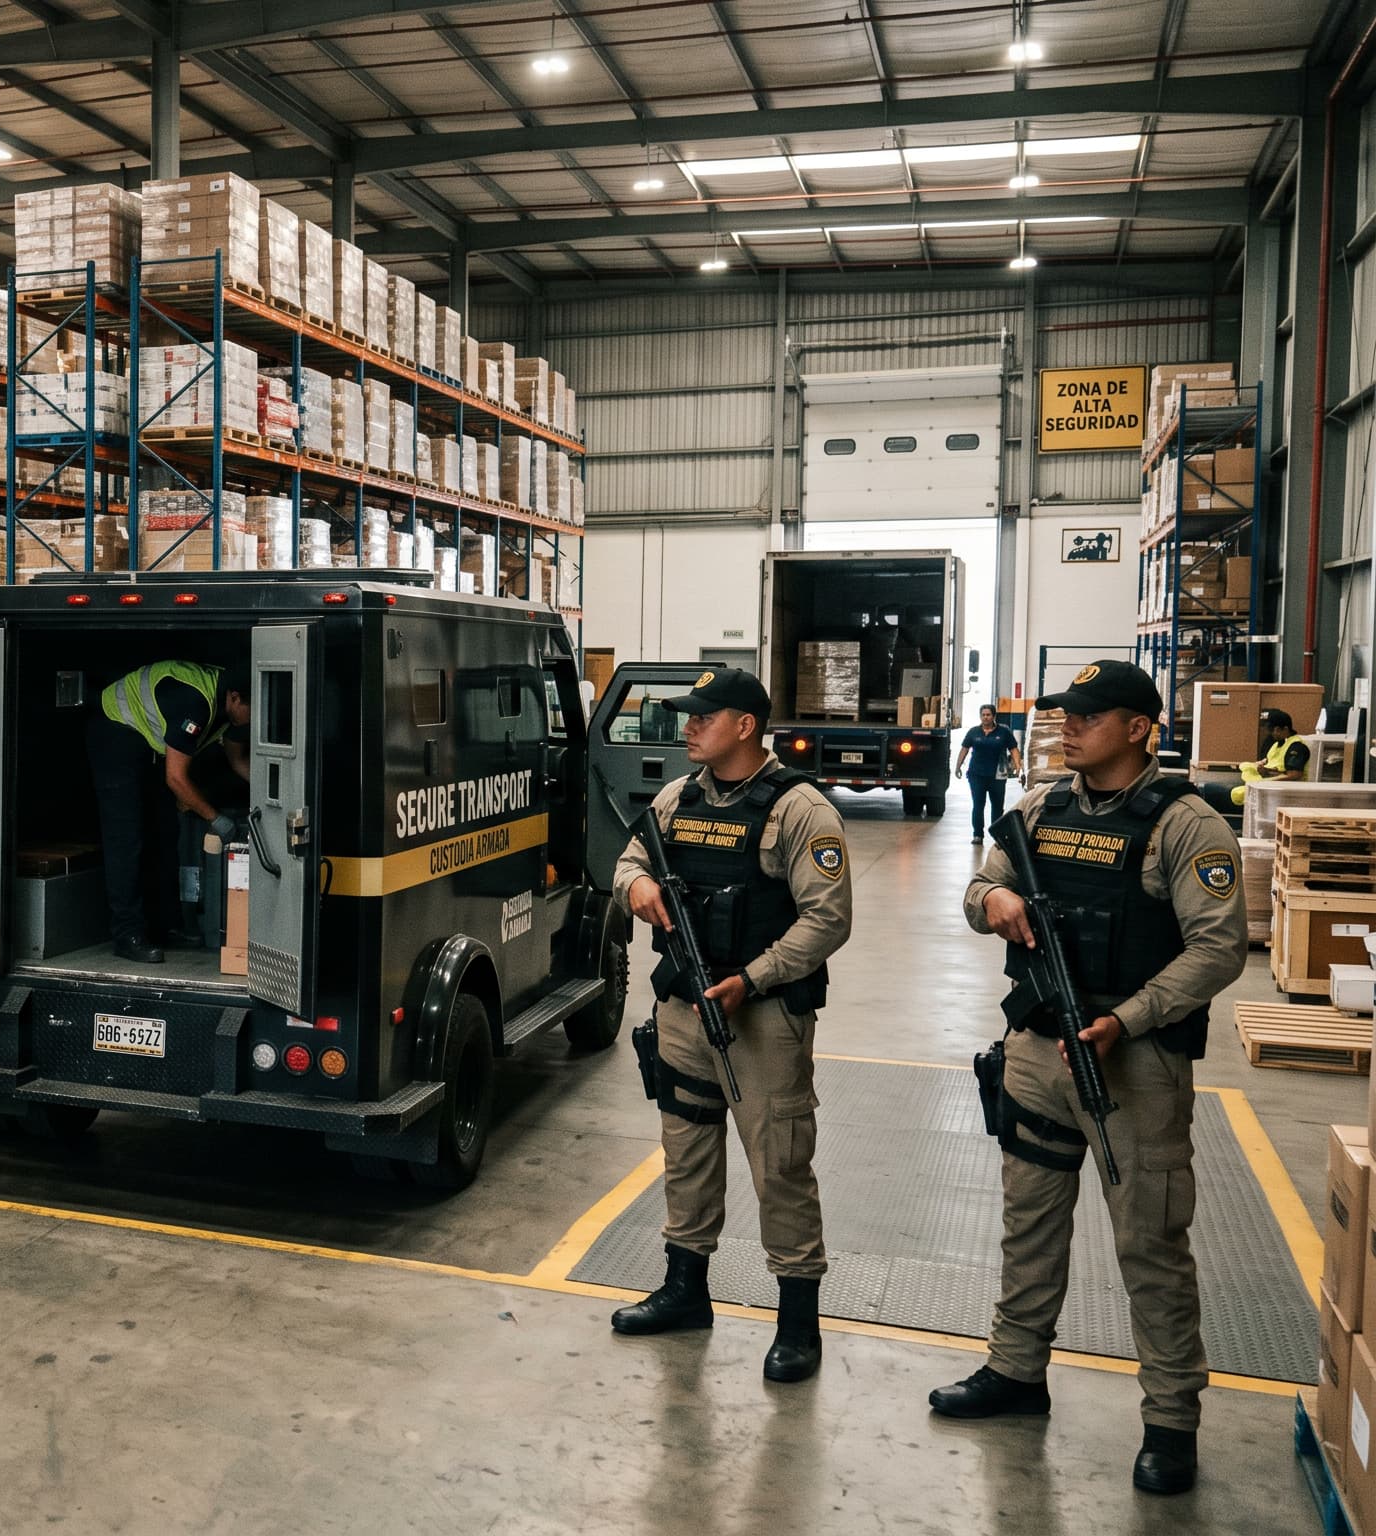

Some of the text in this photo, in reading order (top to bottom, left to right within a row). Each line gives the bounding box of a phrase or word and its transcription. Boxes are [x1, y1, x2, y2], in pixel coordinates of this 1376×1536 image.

[1057, 380, 1128, 397] ZONA DE
[1072, 398, 1112, 413] ALTA
[1045, 414, 1139, 432] SEGURIDAD
[396, 769, 532, 839] SECURE TRANSPORT
[430, 837, 474, 875] CUSTODIA
